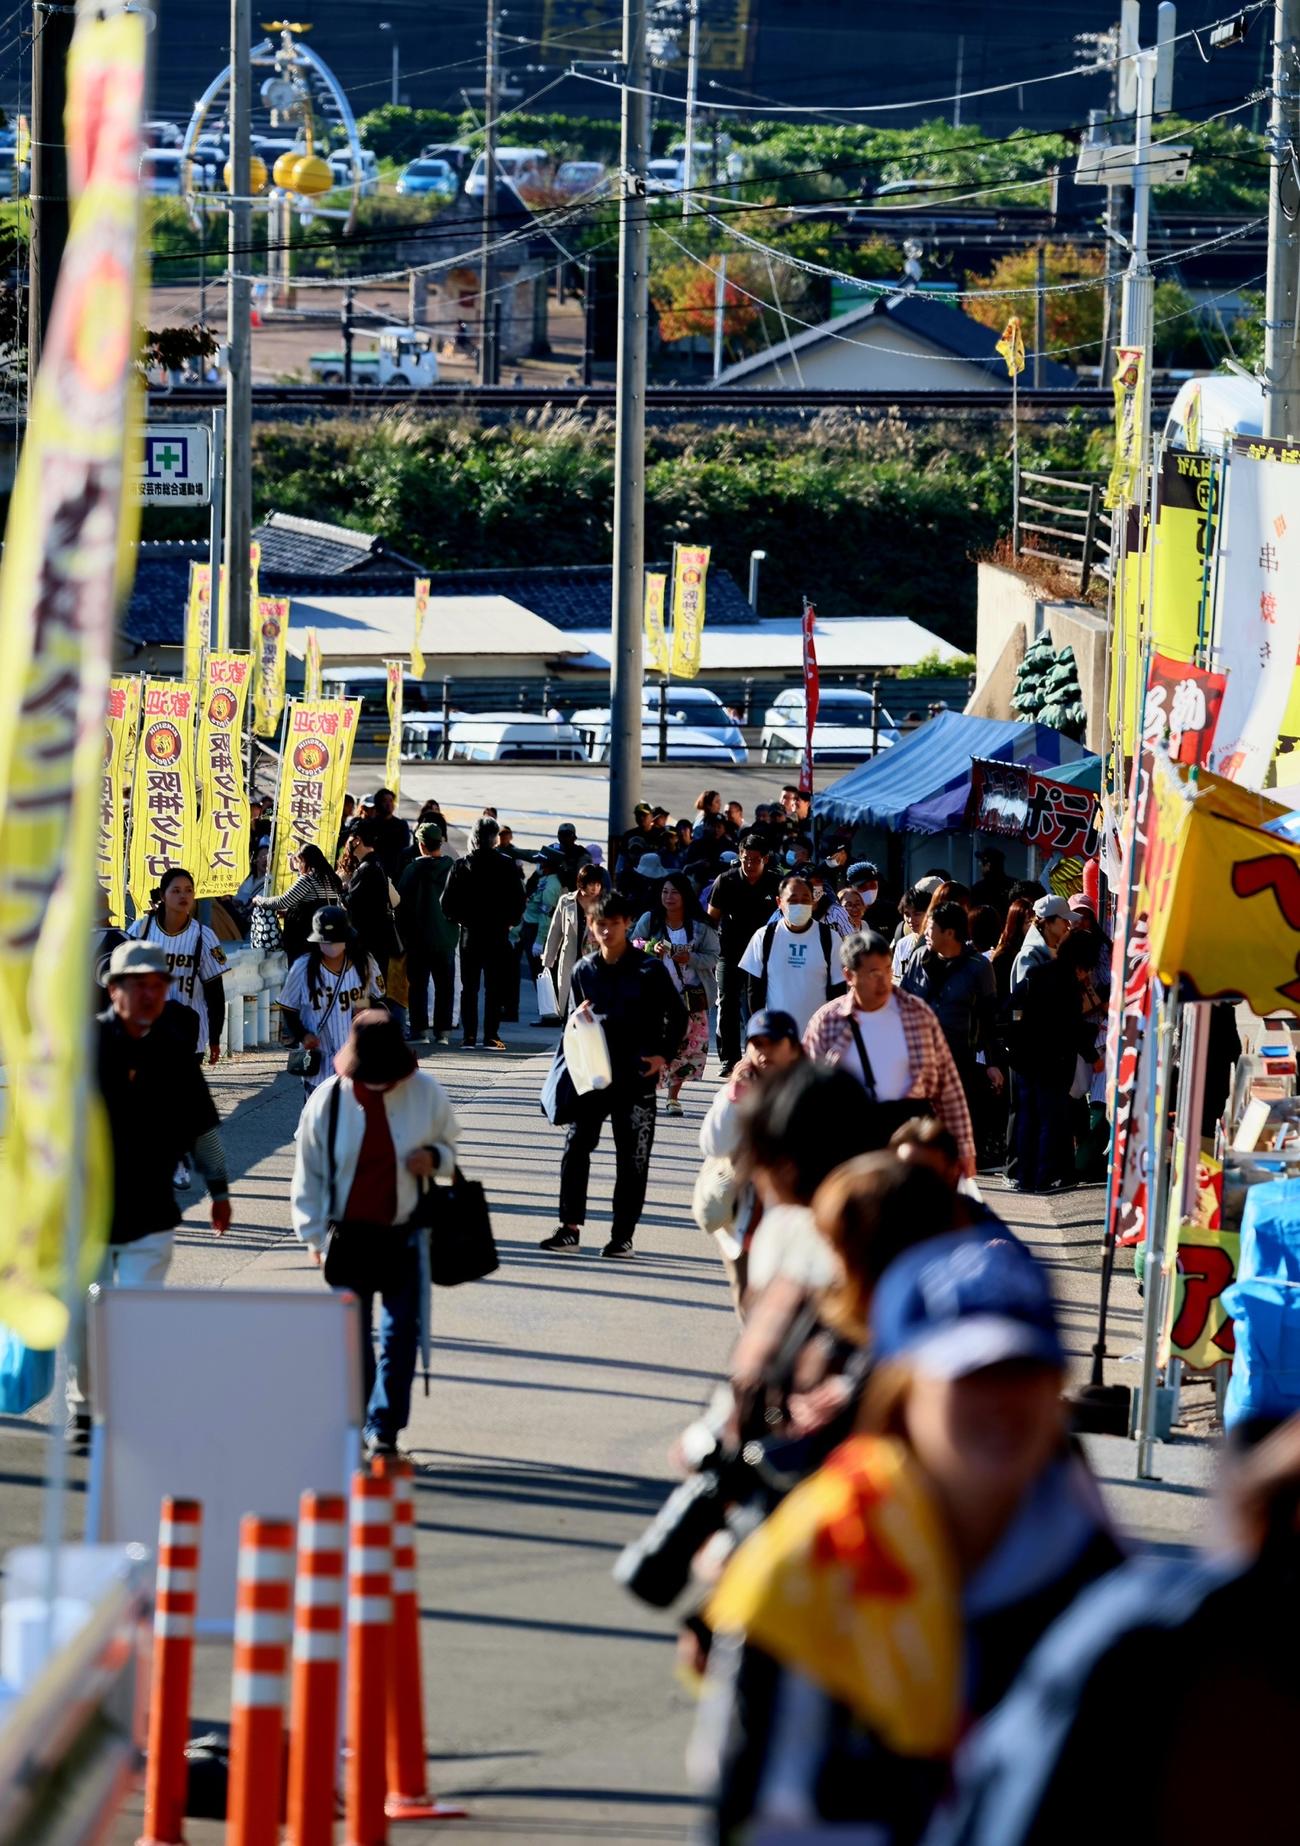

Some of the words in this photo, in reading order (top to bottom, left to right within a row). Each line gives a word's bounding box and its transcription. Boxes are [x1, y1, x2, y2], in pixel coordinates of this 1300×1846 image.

[1258, 542, 1279, 668] 串焼き
[178, 975, 194, 999] 19
